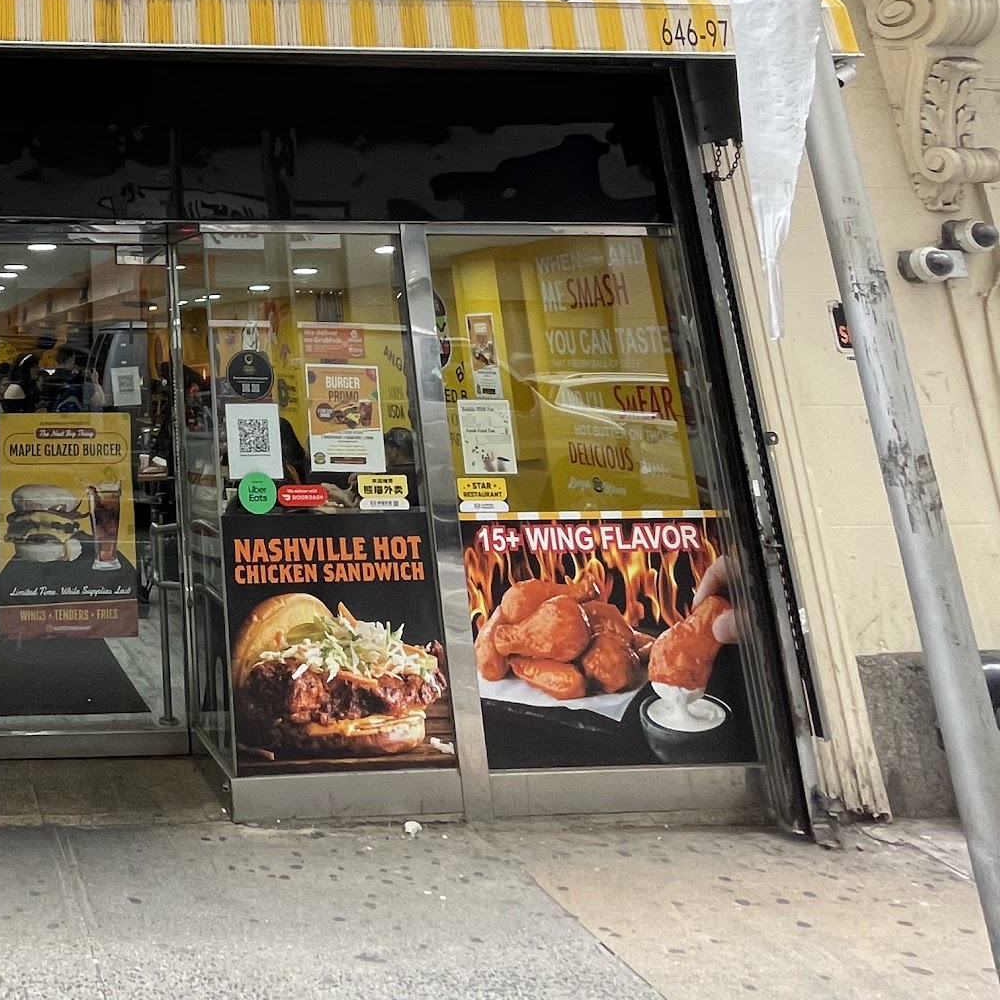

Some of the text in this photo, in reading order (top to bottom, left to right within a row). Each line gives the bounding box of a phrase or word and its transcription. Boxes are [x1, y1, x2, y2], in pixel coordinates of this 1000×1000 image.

[566, 273, 630, 310] SMASH
[545, 325, 672, 355] YOU CAN TASTE
[325, 376, 361, 389] BURGER
[328, 390, 359, 402] PROMO
[387, 404, 406, 420] USDA
[9, 443, 122, 457] MAPLE GLAZED BURGER
[568, 441, 634, 472] DELICIOUS
[248, 485, 267, 494] Uber
[472, 482, 492, 490] STAR
[249, 494, 268, 502] Eats
[478, 524, 701, 552] 15+ WING FLAVOR
[234, 535, 422, 562] NASHVILLE HOT
[234, 562, 425, 584] CHICKEN SANDWICH
[10, 586, 39, 596] Limited
[82, 585, 113, 598] Supplies
[113, 585, 132, 596] Last
[20, 608, 119, 621] WINGS TENDERS FRIES
